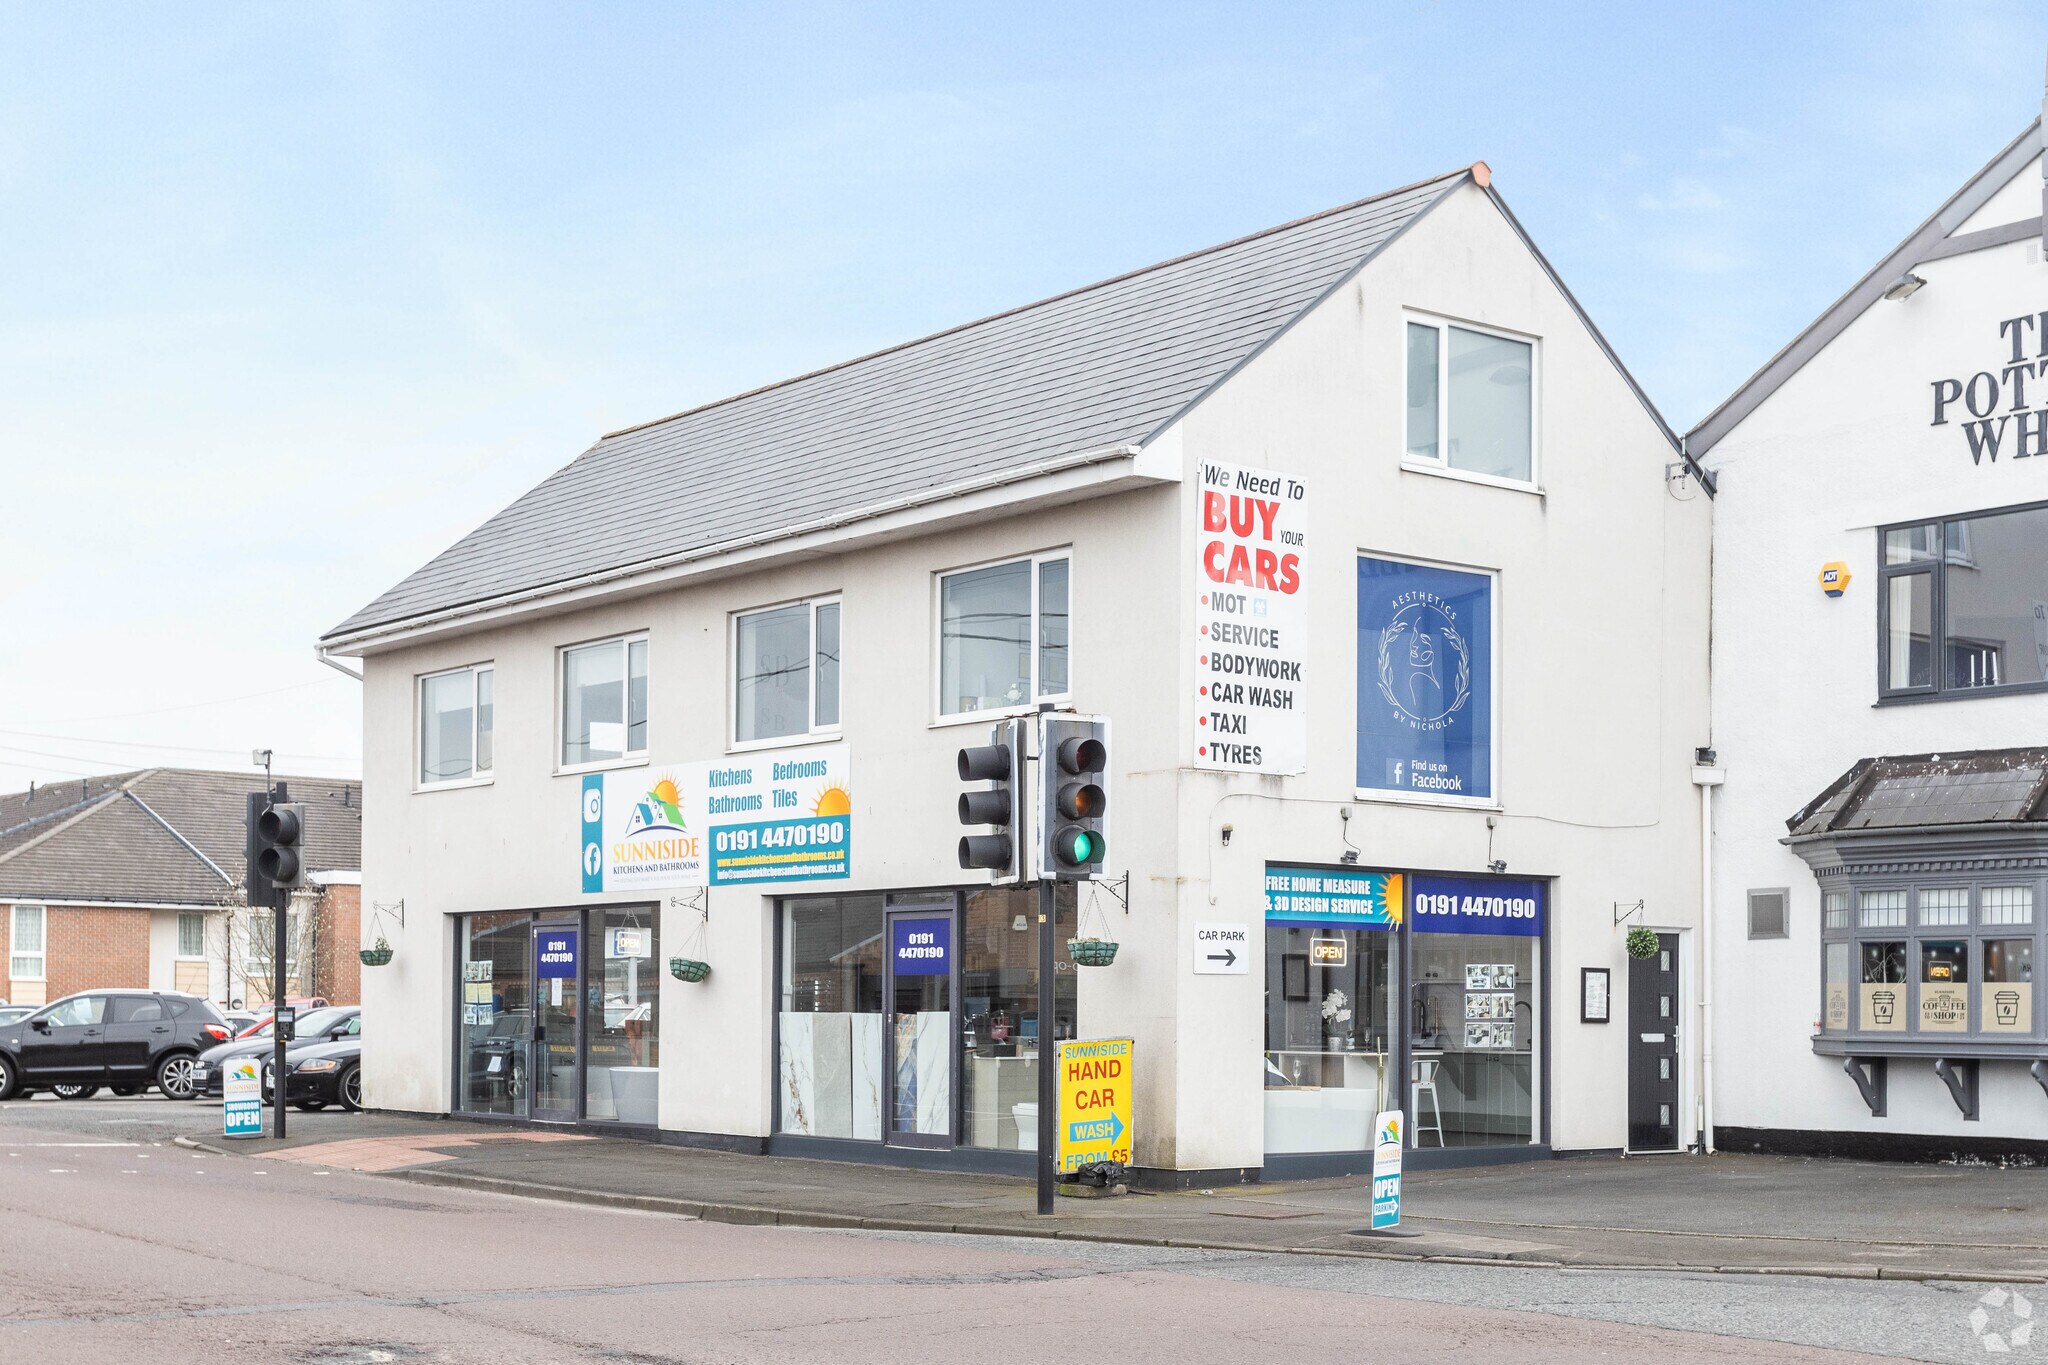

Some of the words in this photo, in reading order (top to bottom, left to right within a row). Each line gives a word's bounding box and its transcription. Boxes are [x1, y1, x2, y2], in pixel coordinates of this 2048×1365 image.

[1931, 359, 2048, 426] POT
[1961, 409, 2048, 466] WH
[1205, 465, 1230, 487] We
[1237, 471, 1281, 496] Need
[1288, 480, 1304, 500] To
[1204, 490, 1281, 541] BUY
[1281, 530, 1304, 546] YOUR
[1204, 541, 1300, 594] CARS
[1824, 571, 1837, 581] ADT
[1212, 592, 1246, 614] MOT
[1392, 591, 1456, 620] AESTHETICS
[1211, 622, 1279, 649] SERVICE
[1211, 652, 1301, 682] BODYWORK
[1212, 682, 1244, 704] CAR
[1249, 686, 1293, 710] WASH
[1211, 712, 1246, 734] TAXI
[1394, 712, 1405, 722] BY
[1410, 717, 1454, 730] NICHOLA
[1210, 742, 1262, 765] TYRES
[709, 768, 752, 788] Kitchens
[773, 760, 827, 780] Bedrooms
[1412, 760, 1426, 770] Find
[1429, 763, 1437, 771] us
[1439, 764, 1447, 772] on
[1412, 773, 1461, 791] Facebook
[709, 794, 762, 814] Bathrooms
[772, 789, 797, 808] Tiles
[716, 829, 757, 852] 0191
[761, 822, 843, 848] 4470190
[613, 838, 699, 863] SUNNISIDE
[614, 865, 643, 875] KITCHENS
[644, 864, 658, 872] AND
[660, 861, 699, 871] BATHROOMS
[1266, 876, 1289, 891] FREE
[1292, 877, 1321, 893] HOME
[1323, 878, 1370, 895] MEASURE
[1265, 898, 1272, 910] &
[1275, 898, 1289, 912] 3D
[1291, 898, 1329, 913] DESIGN
[1331, 899, 1373, 915] SERVICE
[1416, 894, 1458, 916] 0191
[1461, 895, 1536, 918] 4470190
[548, 941, 566, 951] 0191
[909, 933, 934, 945] 0191
[1199, 930, 1218, 940] CAR
[1221, 931, 1245, 941] PARK
[541, 953, 573, 963] 4470190
[899, 947, 944, 959] 4470190
[1314, 946, 1343, 959] OPEN
[1065, 1044, 1127, 1059] SUNNISIDE
[1069, 1060, 1121, 1082] HAND
[1076, 1089, 1114, 1110] CAR
[227, 1111, 259, 1127] OPEN
[1075, 1123, 1114, 1139] WASH
[1066, 1151, 1107, 1169] FROM
[1112, 1149, 1128, 1163] £5
[1375, 1178, 1399, 1199] OPEN
[1375, 1203, 1395, 1213] PARKING
